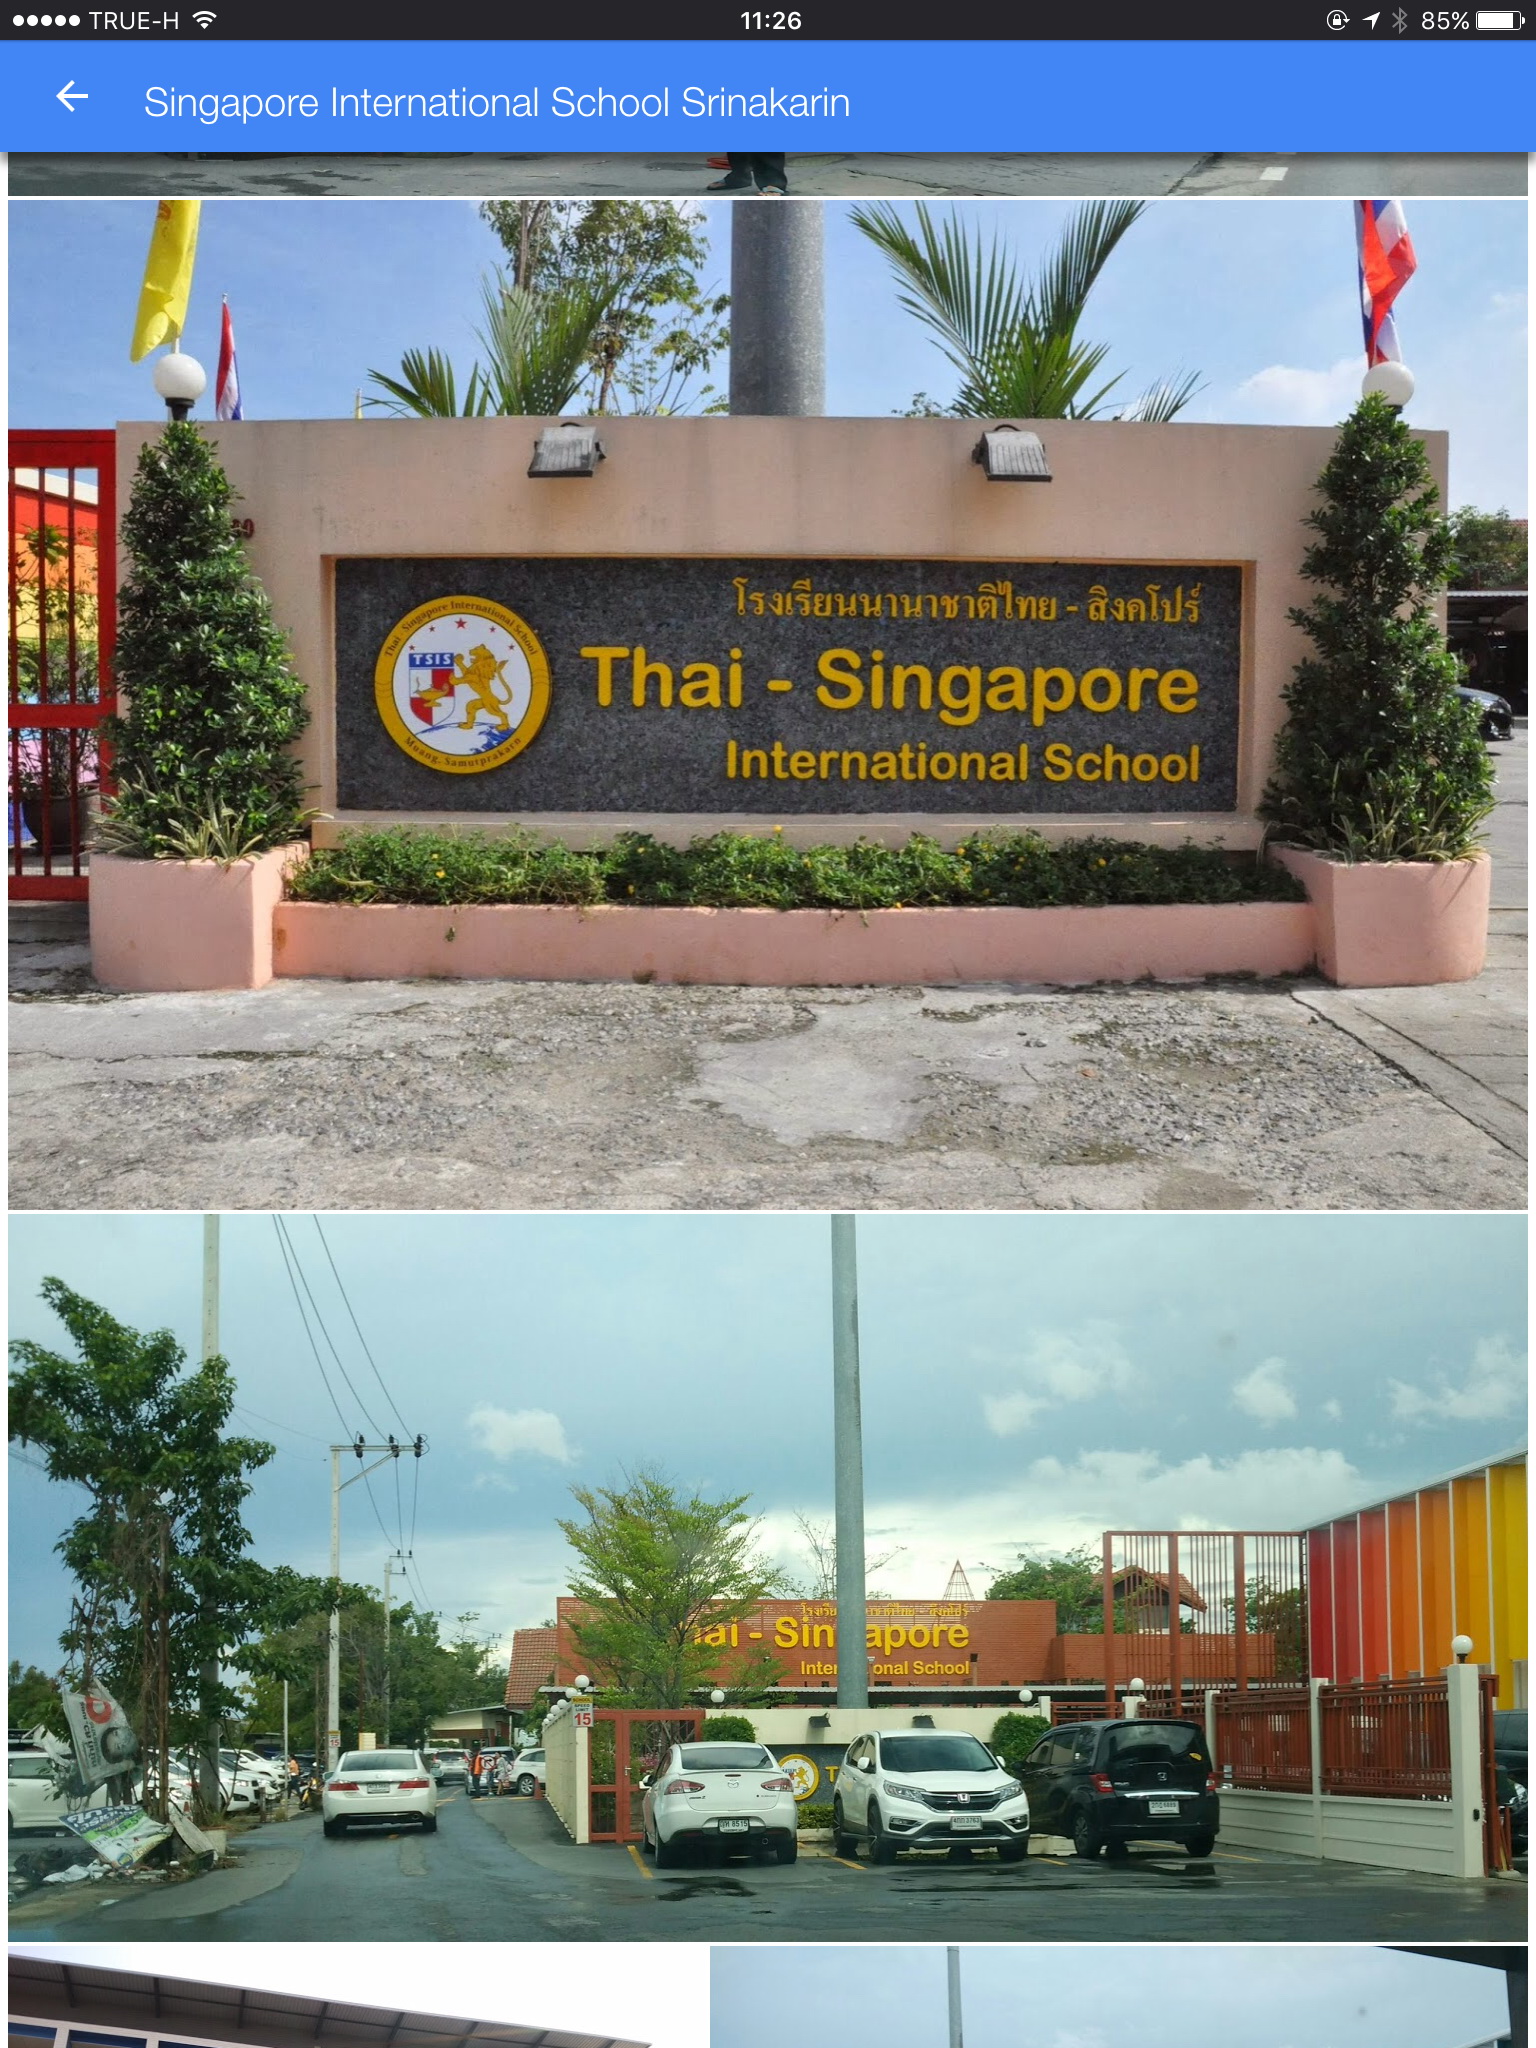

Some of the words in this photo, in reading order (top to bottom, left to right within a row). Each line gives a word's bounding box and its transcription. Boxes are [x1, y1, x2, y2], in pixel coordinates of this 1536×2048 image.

[89, 12, 179, 30] TRUE-H
[741, 12, 802, 30] 11:26
[1421, 12, 1470, 30] 85%
[144, 86, 319, 124] Singapore
[332, 86, 538, 117] International
[551, 86, 669, 117] School
[682, 86, 850, 117] Srinakarin
[733, 578, 1058, 622] โรงเรียนนานาชาติไทย
[1088, 583, 1202, 624] สิงคโปร์
[384, 635, 402, 657] Thai
[402, 604, 448, 631] Singapore
[450, 601, 515, 627] International
[513, 624, 539, 655] School
[413, 653, 452, 665] TSIS
[580, 646, 744, 709] Thai
[766, 679, 794, 693] -
[816, 647, 1200, 728] Singapore
[444, 737, 522, 767] Samutprakarn
[727, 740, 1029, 782] International
[1043, 743, 1201, 783] School
[774, 1616, 970, 1656] Sinapore
[913, 1660, 970, 1675] School
[574, 1712, 592, 1726] 15
[329, 1738, 340, 1747] 15
[731, 1820, 748, 1828] 8515
